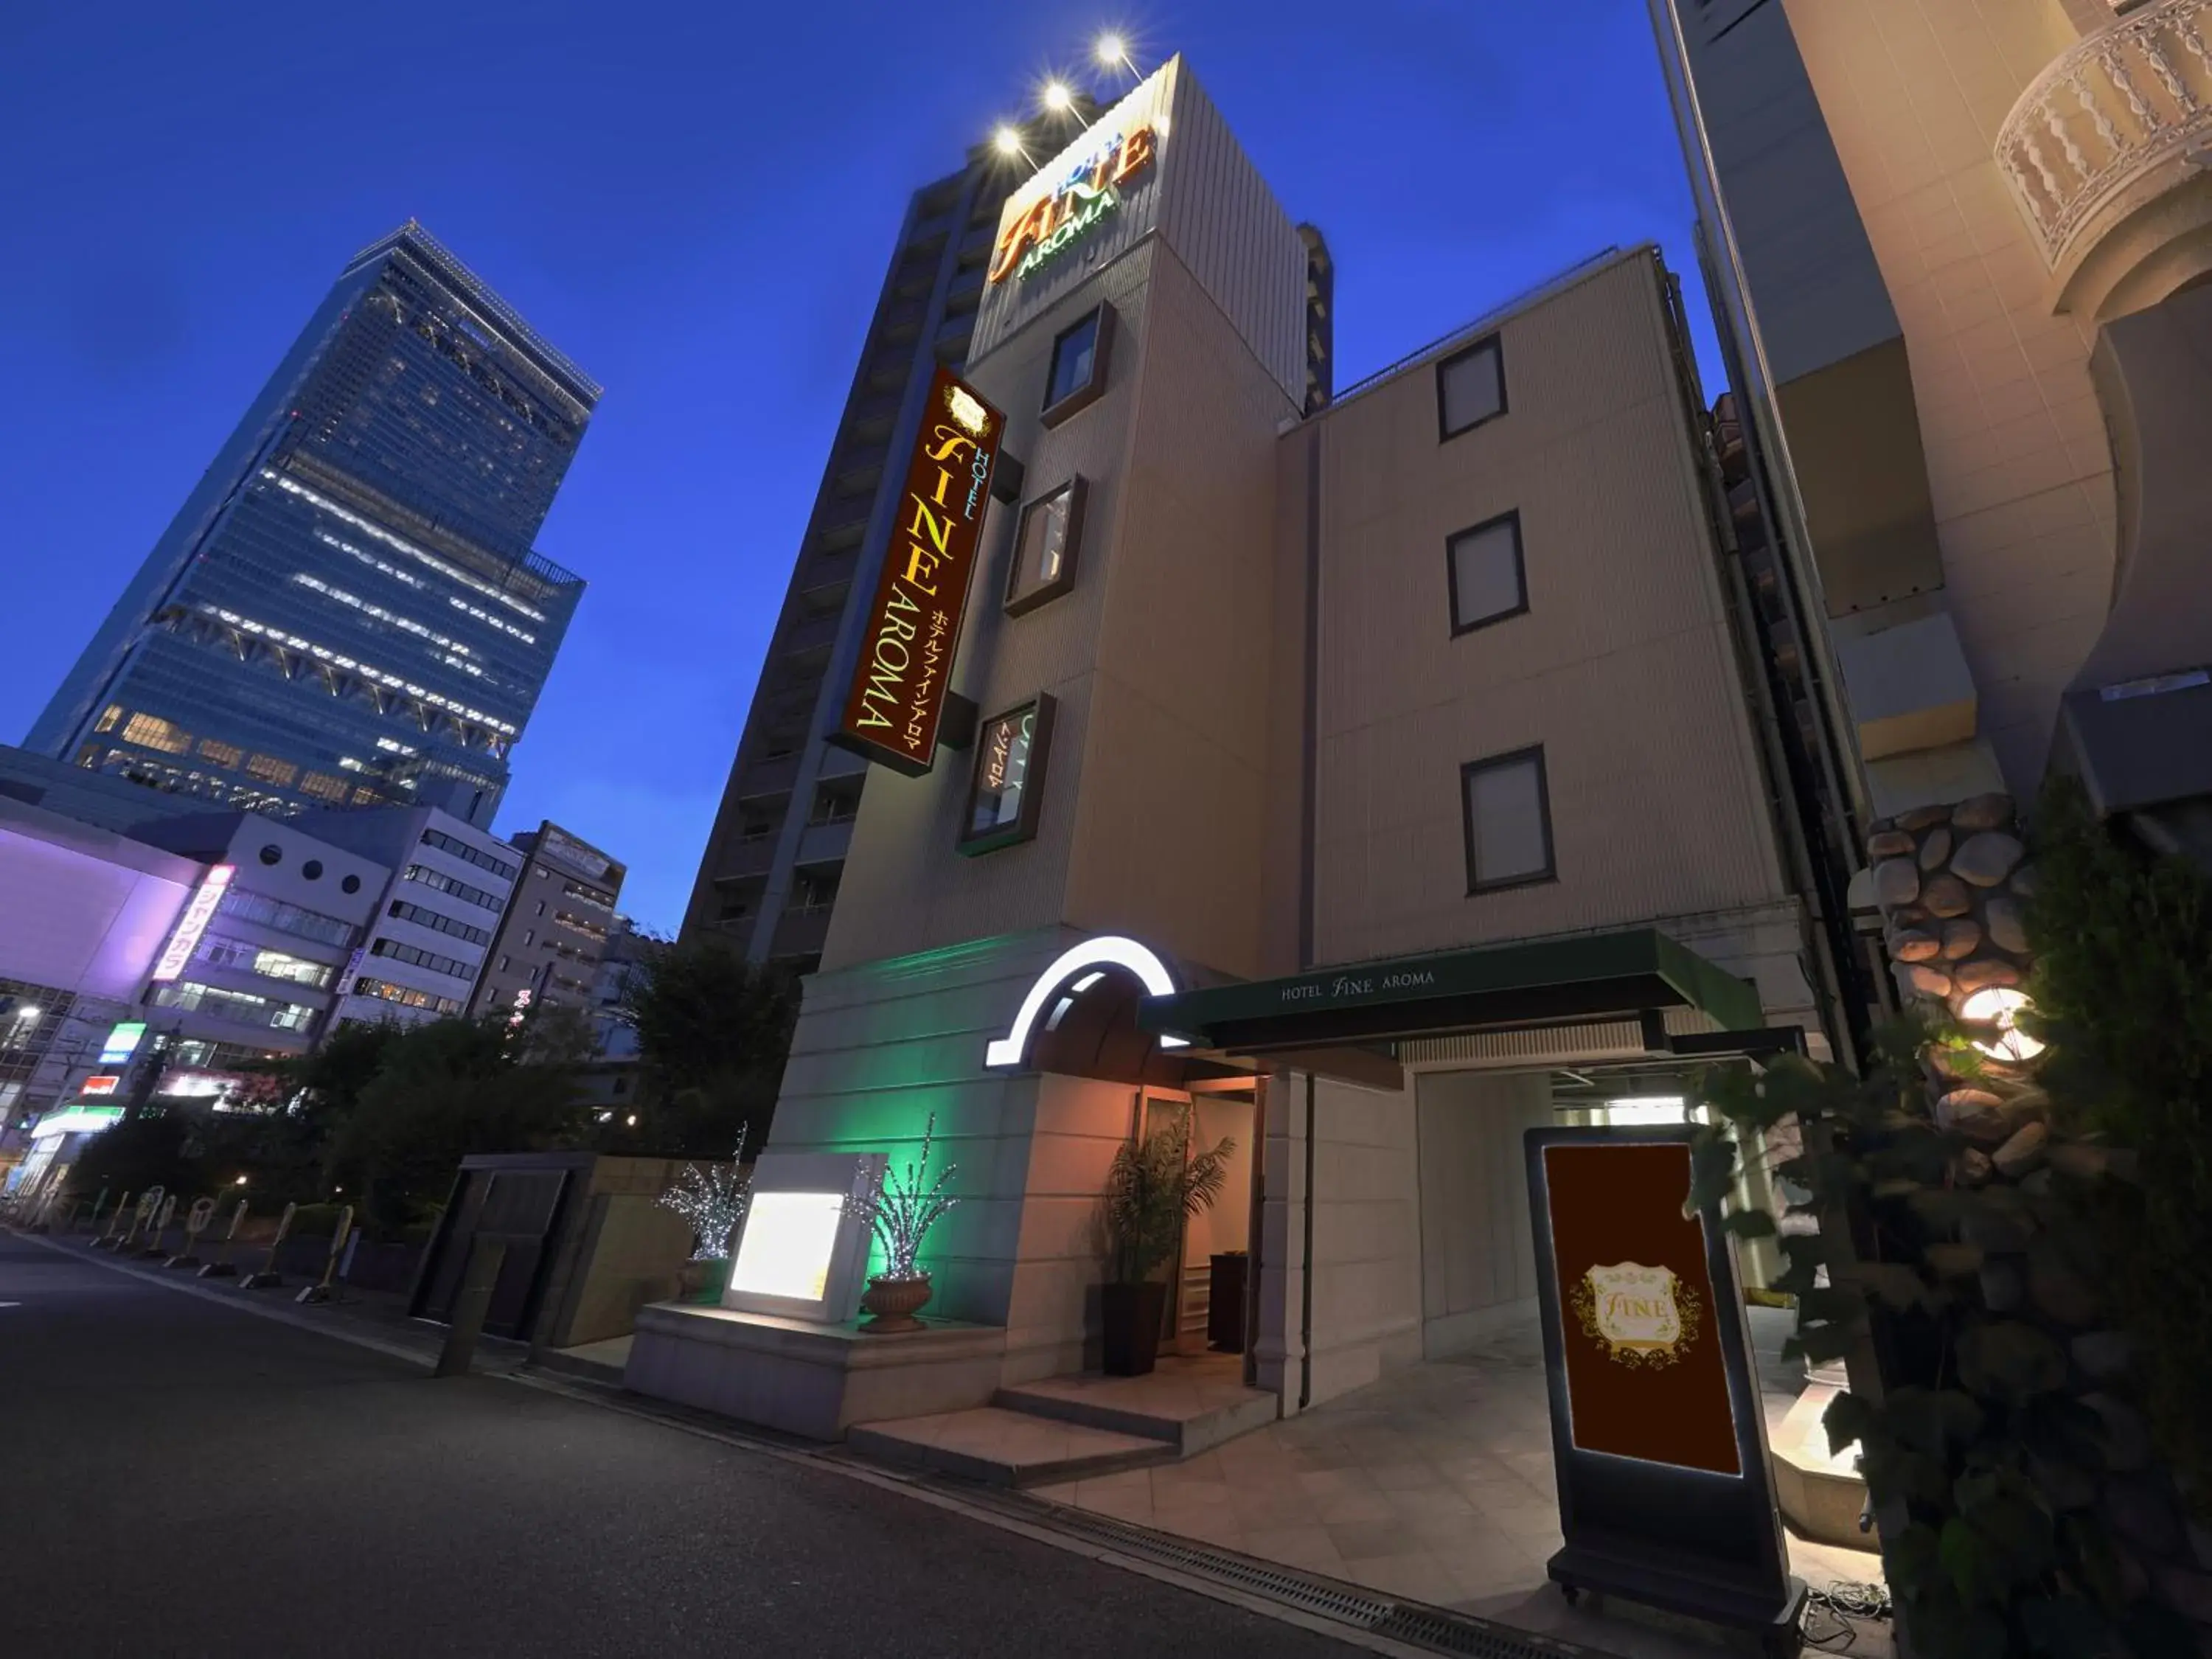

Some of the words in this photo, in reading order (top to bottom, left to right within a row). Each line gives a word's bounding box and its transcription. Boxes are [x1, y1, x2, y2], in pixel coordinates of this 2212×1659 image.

[1018, 189, 1114, 278] AROMA
[900, 425, 977, 597] FINE
[964, 447, 990, 520] HOTEL
[856, 582, 921, 728] AROMA
[1281, 984, 1322, 1001] HOTEL
[1330, 975, 1374, 997] FINE
[1382, 970, 1434, 989] AROMA
[1605, 1291, 1669, 1318] FINE
